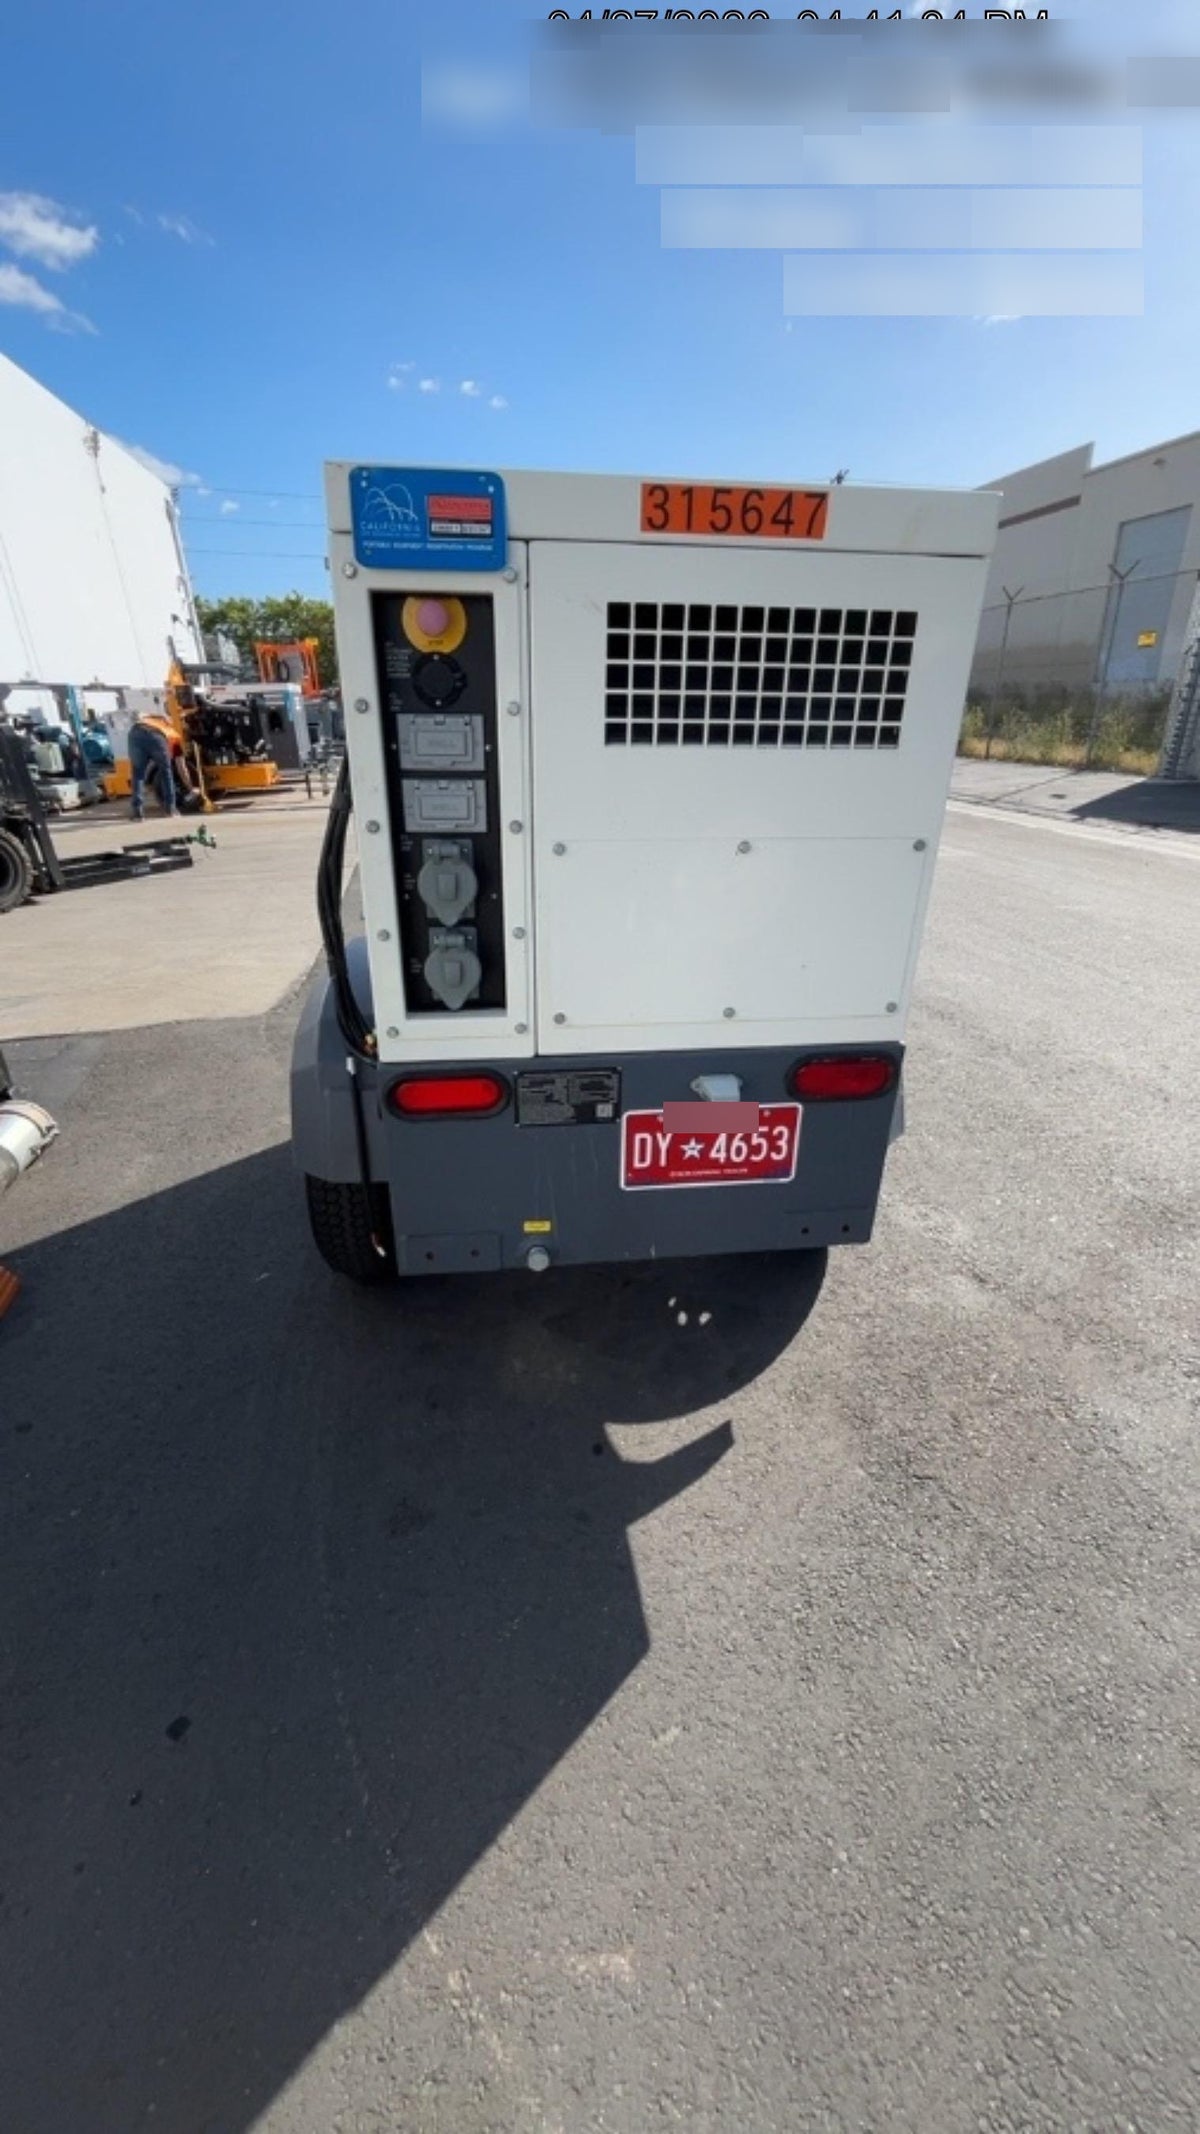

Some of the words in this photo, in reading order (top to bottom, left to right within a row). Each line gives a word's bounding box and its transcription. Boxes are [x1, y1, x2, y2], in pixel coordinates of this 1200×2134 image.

[646, 484, 828, 536] 315647
[632, 1132, 672, 1169] DY
[709, 1125, 789, 1164] 4653
